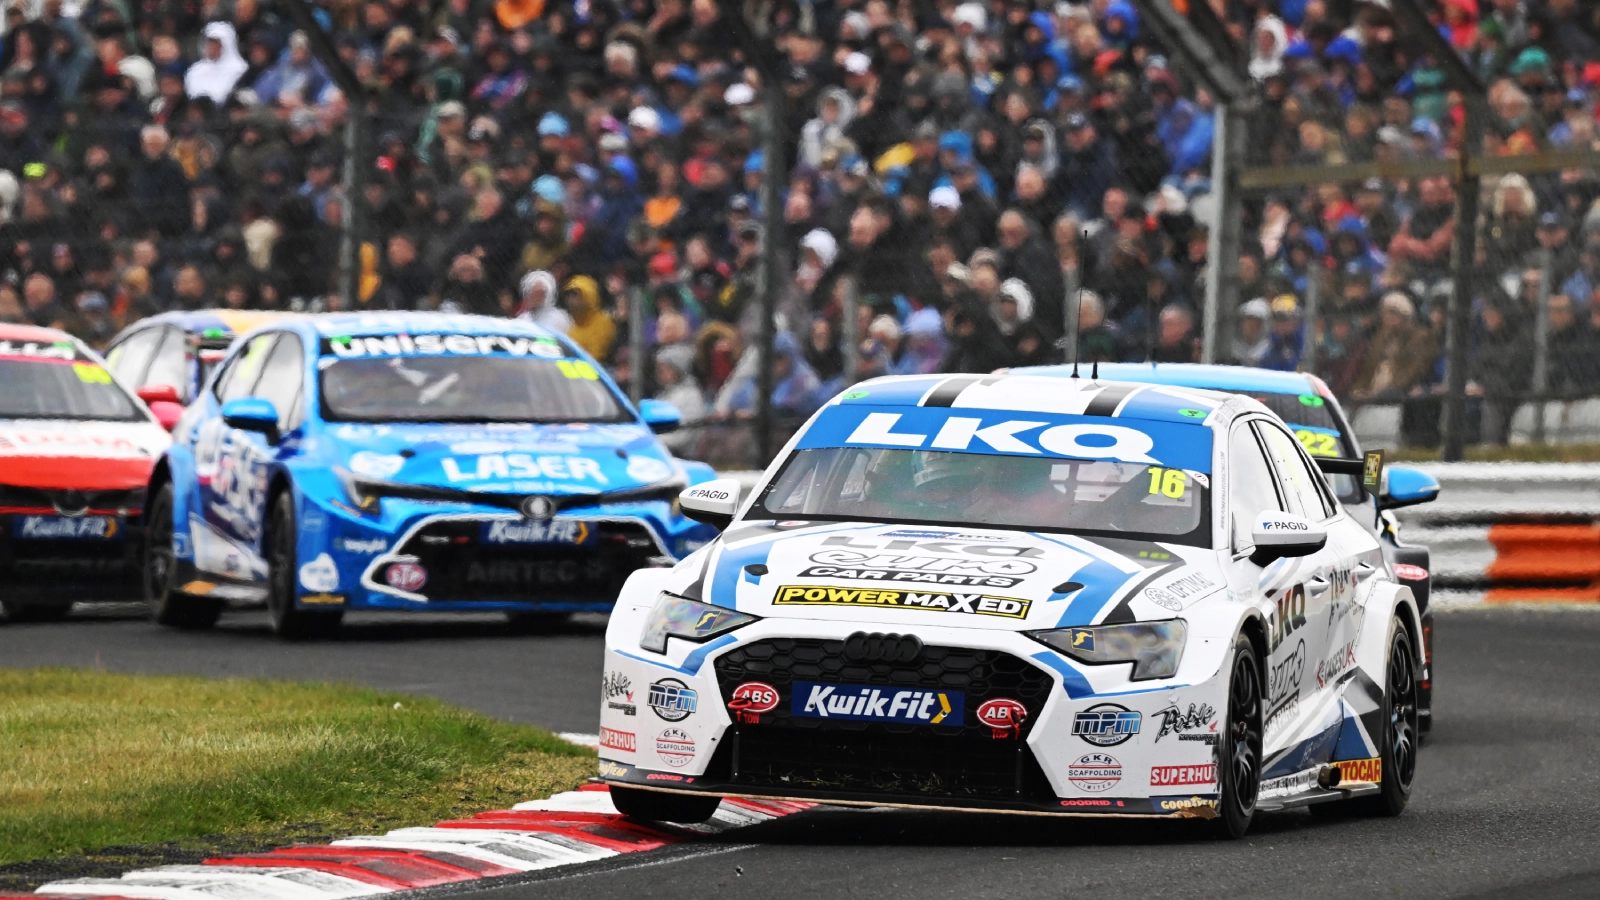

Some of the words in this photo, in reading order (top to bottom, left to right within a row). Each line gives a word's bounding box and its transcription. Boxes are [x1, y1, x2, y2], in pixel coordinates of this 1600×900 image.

[845, 412, 1164, 465] LKQ
[1296, 431, 1338, 457] 22
[441, 454, 608, 484] LASER
[1148, 467, 1187, 499] 16
[697, 489, 729, 501] PAGID
[1274, 521, 1308, 531] PAGID
[820, 536, 1045, 559] LKQ
[809, 567, 888, 579] CAR
[892, 573, 1014, 588] PARTS
[782, 587, 900, 605] POWER
[648, 683, 697, 712] MPM
[741, 690, 773, 704] ABS
[1071, 711, 1142, 736] MPM
[664, 729, 687, 740] GKR
[656, 742, 696, 752] SCAFFOLDING
[663, 756, 688, 765] LIMITED
[1080, 754, 1113, 765] GKR
[1335, 759, 1381, 783] UTOCAR
[1078, 782, 1112, 790] LIMITED
